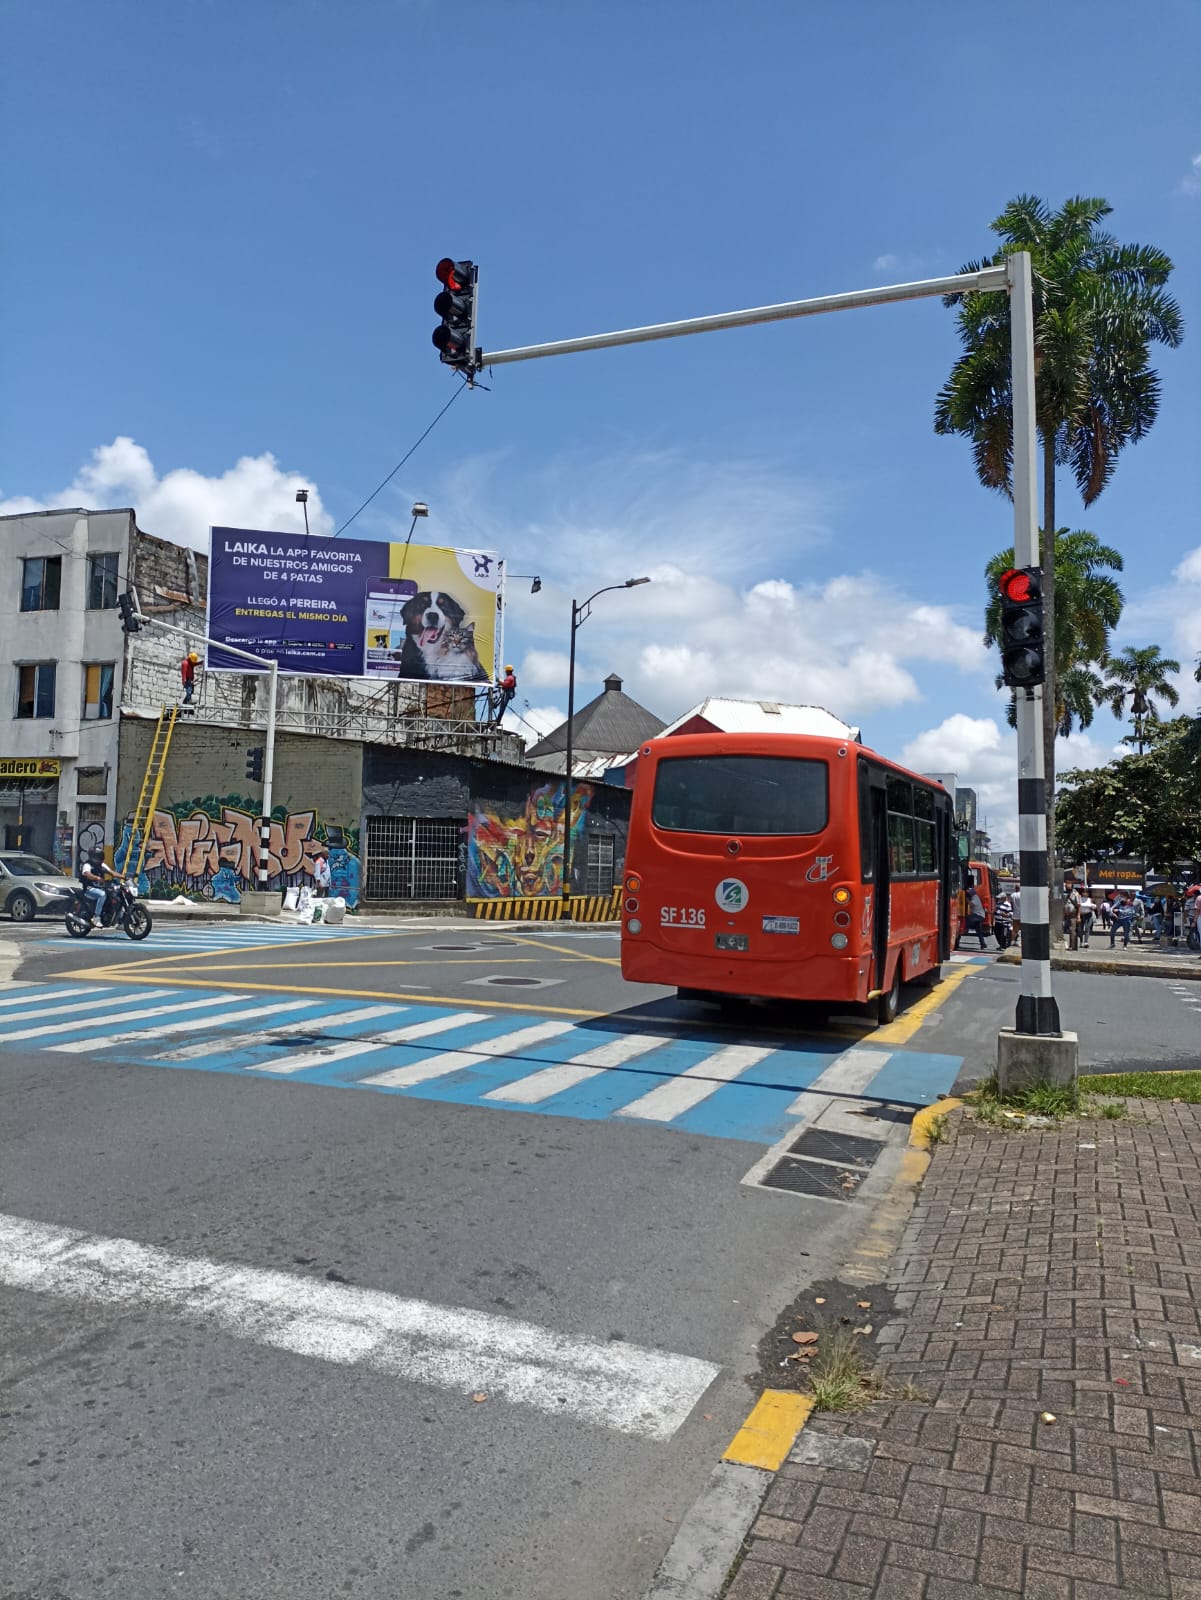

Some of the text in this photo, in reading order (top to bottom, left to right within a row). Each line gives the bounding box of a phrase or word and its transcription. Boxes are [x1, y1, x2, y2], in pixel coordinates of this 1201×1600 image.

[225, 541, 362, 562] LAIKA LA APP FAVORITA
[232, 556, 354, 573] DE NUESTROS AMIGOS
[263, 571, 323, 583] DE 4 PATAS
[247, 595, 337, 610] LLEGÓ A PEREIRA
[235, 608, 348, 623] ENTREGAS EL MISMO DÍA
[660, 906, 706, 925] SF 136
